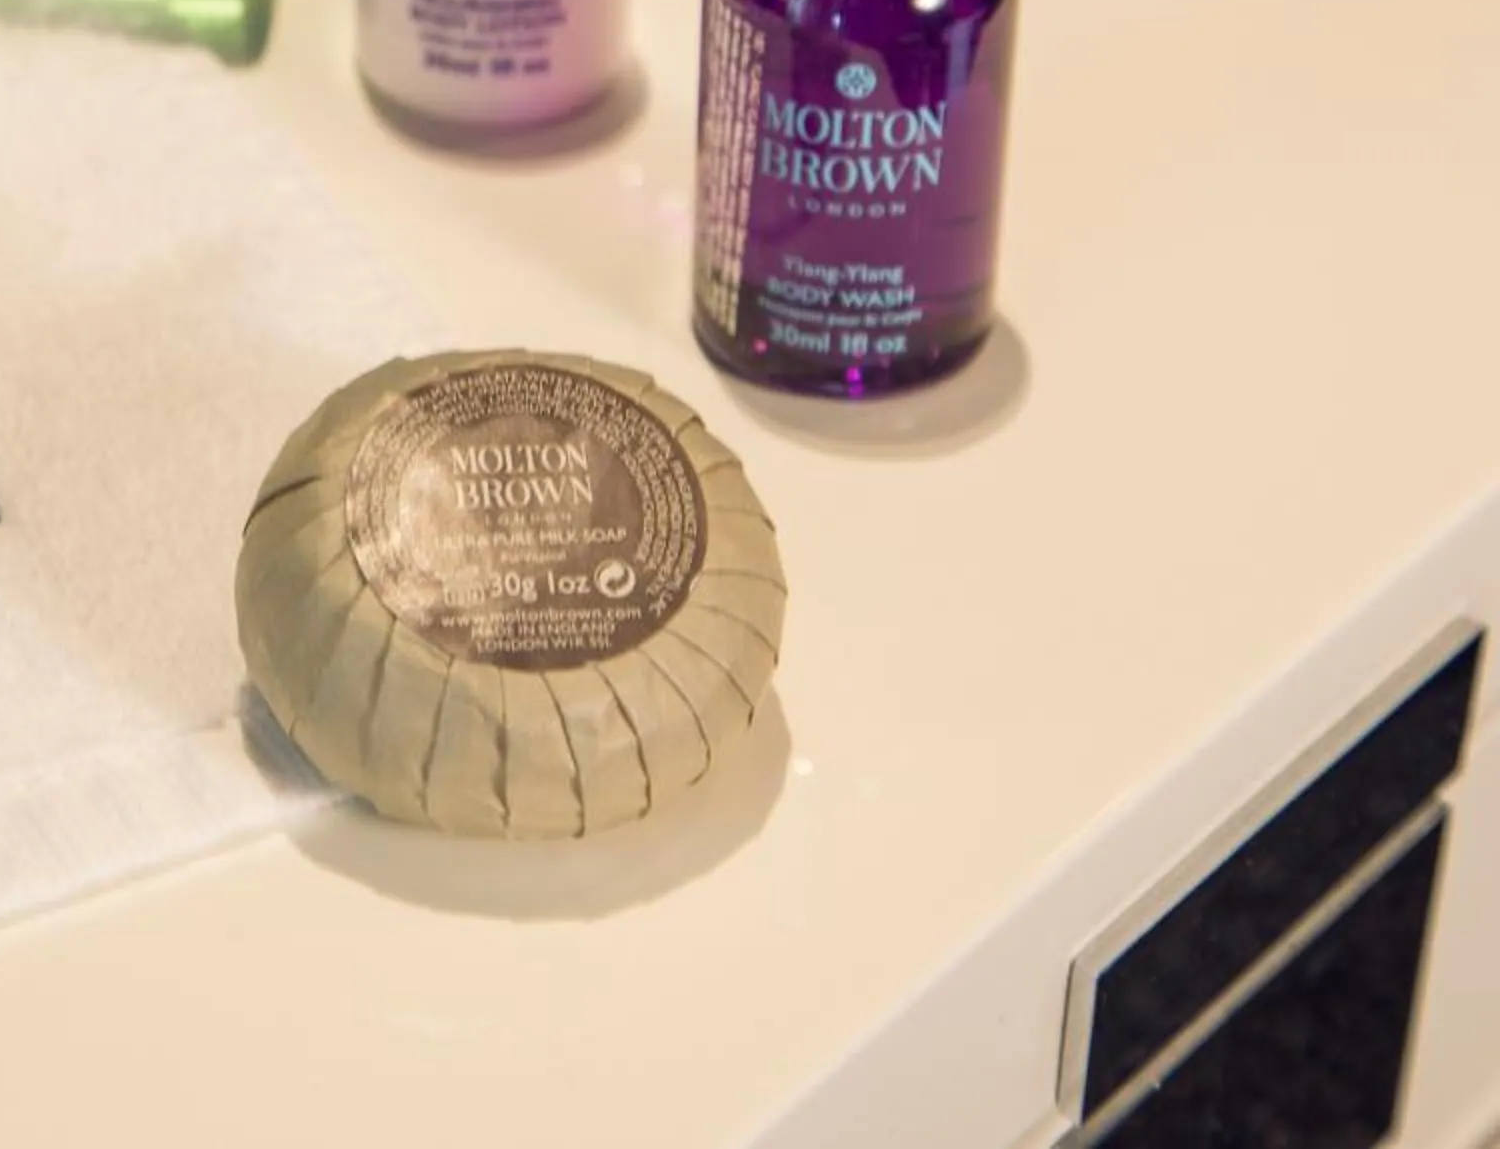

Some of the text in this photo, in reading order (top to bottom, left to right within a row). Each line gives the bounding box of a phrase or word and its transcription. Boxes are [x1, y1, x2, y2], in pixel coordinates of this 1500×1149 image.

[761, 92, 947, 150] MOLTON
[759, 136, 944, 195] BROWN
[787, 194, 908, 219] LONDON
[782, 252, 904, 288] Ylang-Ylang
[766, 275, 917, 310] BODY WASH
[768, 319, 832, 355] 30ml
[875, 334, 908, 355] oz
[450, 441, 590, 476] MOLTON
[453, 474, 594, 510] BROWN
[493, 529, 534, 547] PURE
[538, 528, 578, 545] MILK
[583, 527, 627, 545] SOAP
[489, 570, 539, 603] 30g
[440, 606, 642, 628] www.moltonbrown.com
[471, 619, 616, 640] MADE IN ENGLAND
[476, 635, 549, 654] LONDON
